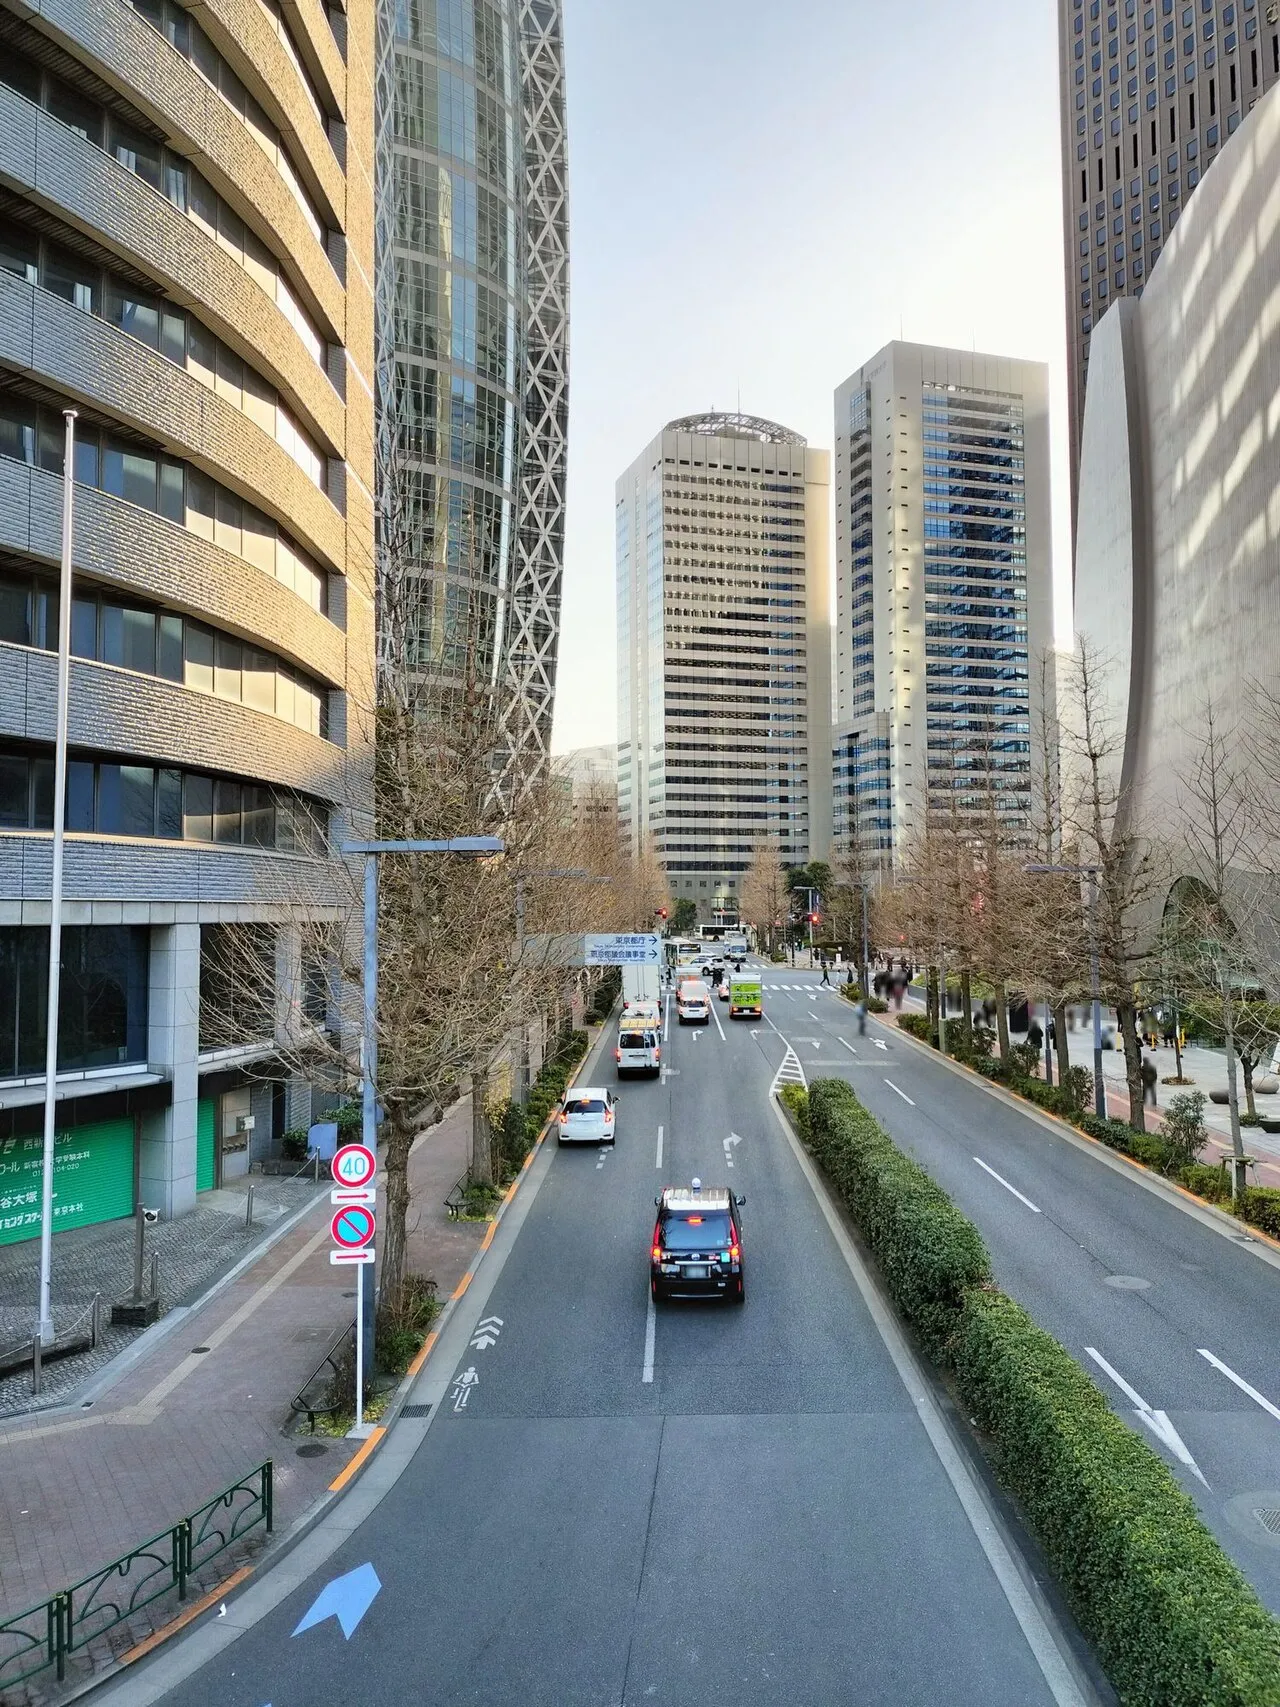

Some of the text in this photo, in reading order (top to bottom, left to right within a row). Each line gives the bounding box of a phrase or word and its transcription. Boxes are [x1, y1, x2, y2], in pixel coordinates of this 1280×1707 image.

[24, 1133, 72, 1150] 西新ビル
[342, 1157, 366, 1176] 40
